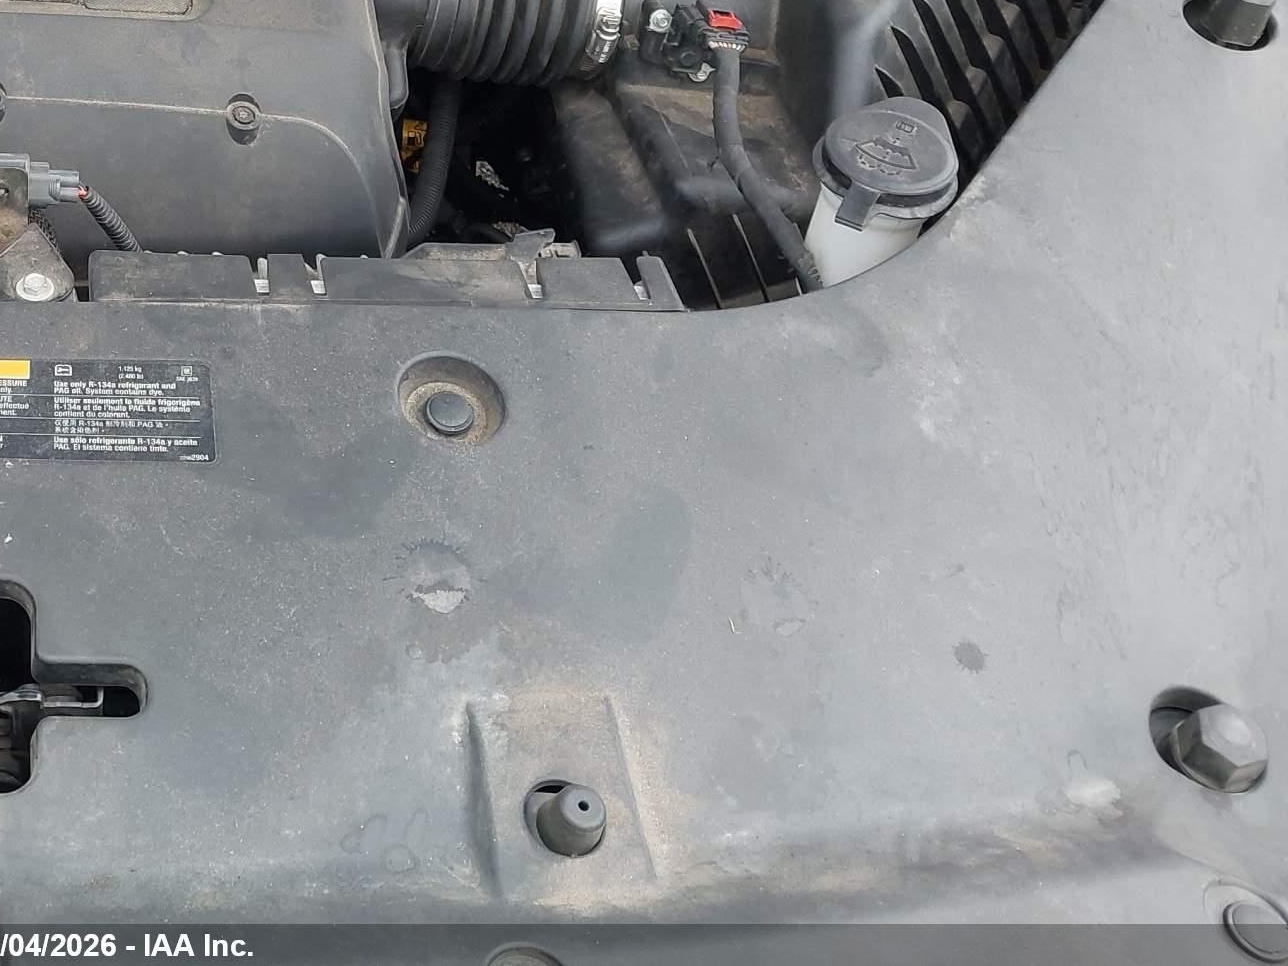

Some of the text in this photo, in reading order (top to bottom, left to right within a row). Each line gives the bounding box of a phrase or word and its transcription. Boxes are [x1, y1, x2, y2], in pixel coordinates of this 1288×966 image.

[118, 382, 159, 390] refrigerant
[85, 388, 112, 396] System
[89, 437, 136, 445] refrigerante
